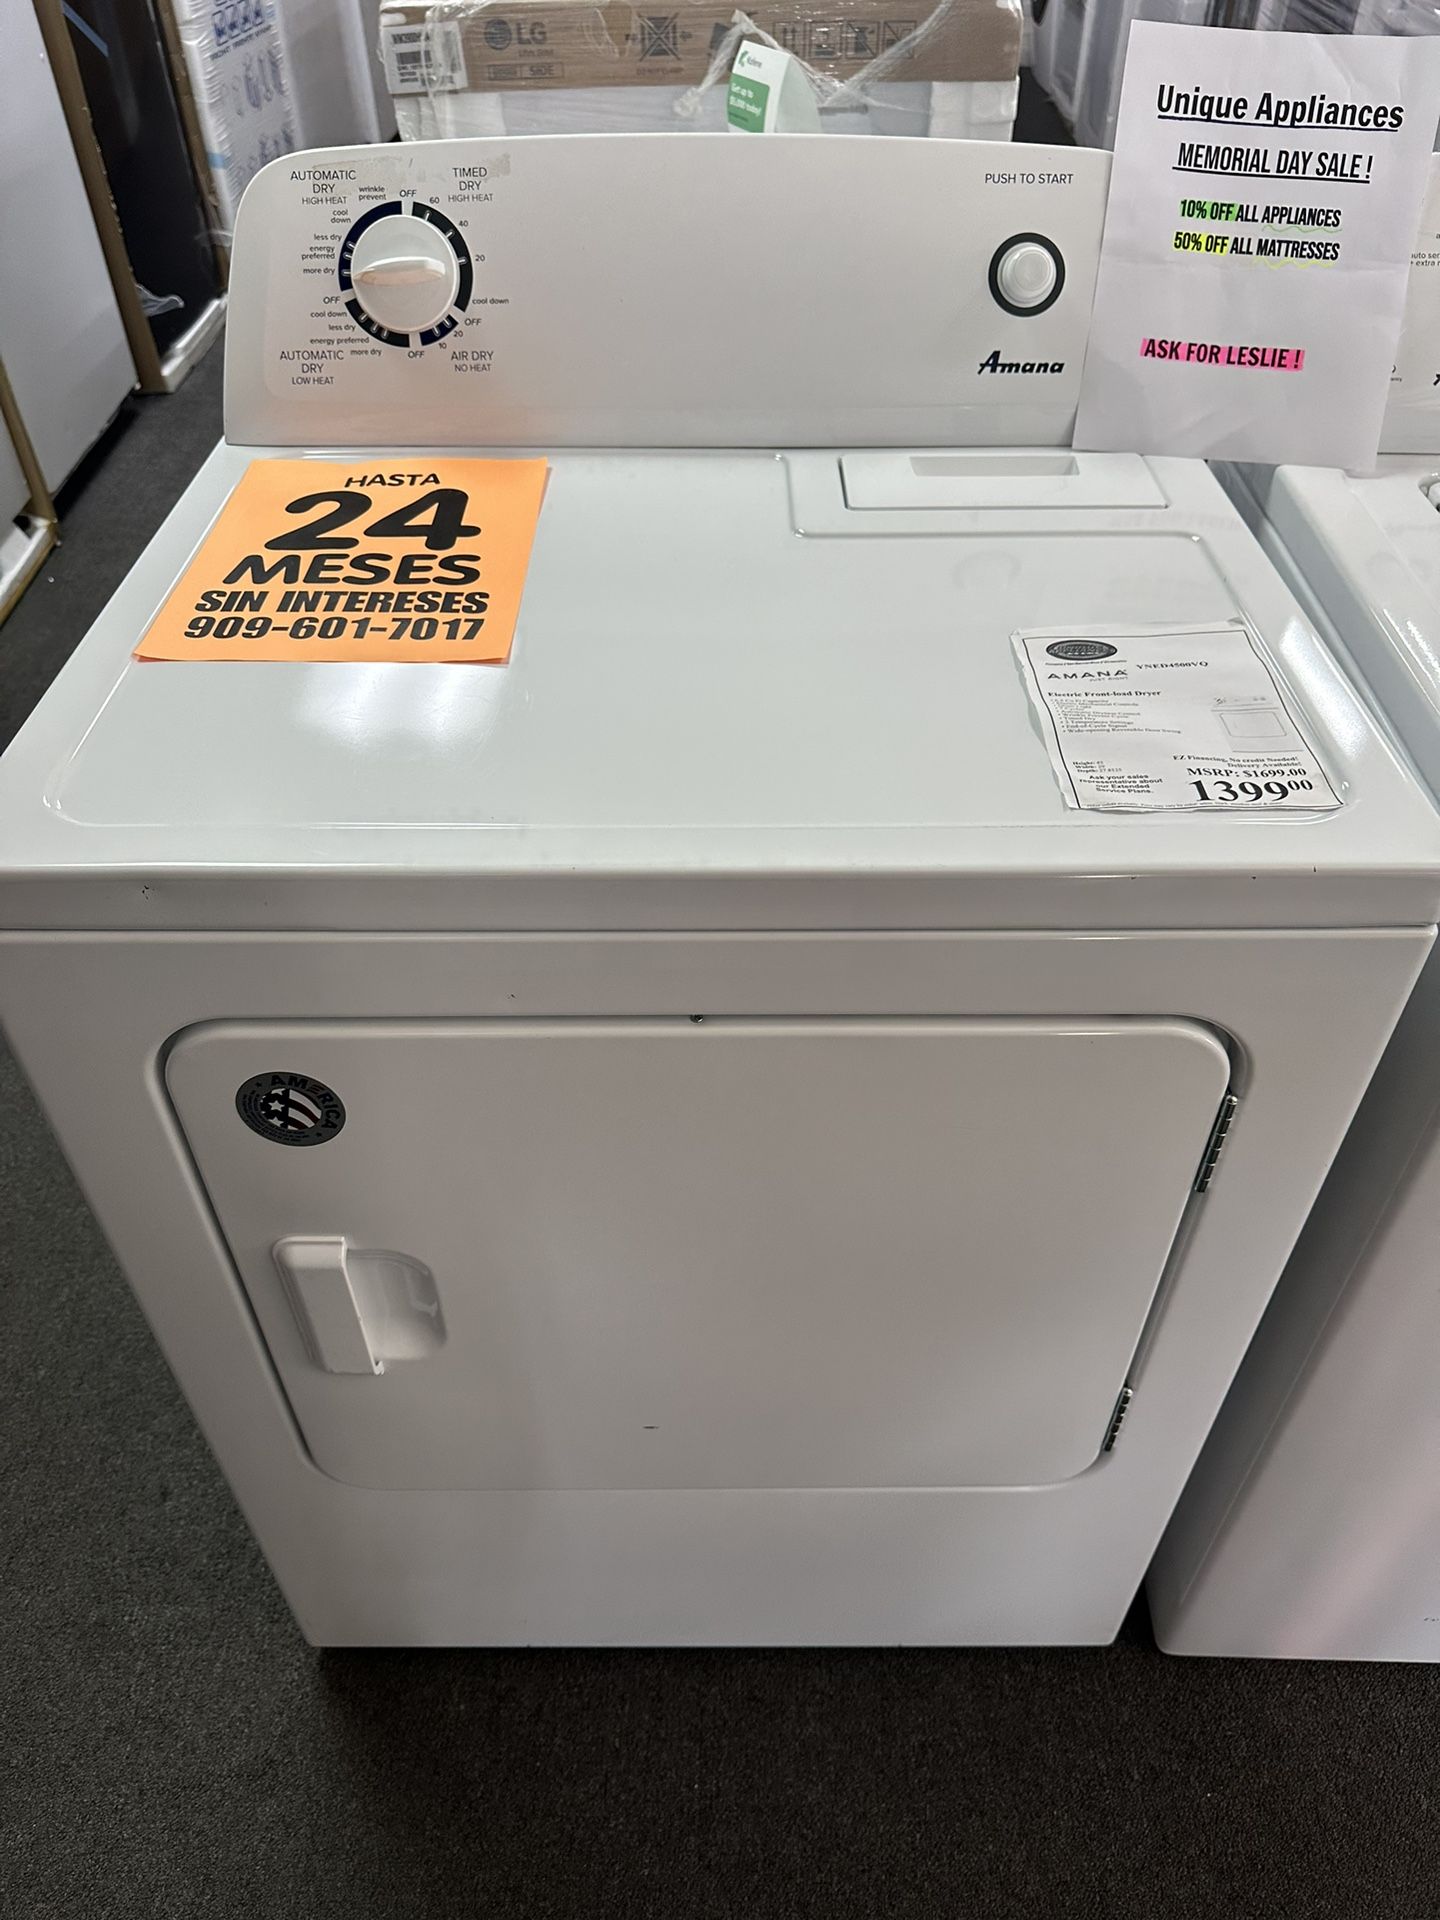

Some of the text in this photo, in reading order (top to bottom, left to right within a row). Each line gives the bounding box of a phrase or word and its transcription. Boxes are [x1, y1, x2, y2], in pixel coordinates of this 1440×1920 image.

[516, 22, 547, 45] LG
[1156, 84, 1404, 129] Unique Appliances
[1178, 142, 1272, 174] MEMORIAL
[1275, 150, 1312, 176] DAY
[1315, 151, 1363, 178] SALE
[290, 169, 357, 181] AUTOMATIC
[452, 167, 487, 178] TIMED
[984, 173, 1074, 185] PUSH TO START
[312, 183, 335, 194] DRY
[459, 180, 482, 191] DRY
[358, 194, 387, 202] prevent
[399, 189, 417, 198] OFF
[448, 193, 493, 203] HIGH HEAT
[301, 196, 347, 205] HIGH HEAT
[429, 196, 440, 204] 60
[1180, 199, 1342, 227] 10% OFF ALL APPLIANCES
[331, 216, 351, 224] down
[458, 220, 468, 228] 40
[314, 233, 342, 242] less dry
[1173, 232, 1340, 261] 50% OFF ALL MATTRESSES
[301, 252, 335, 261] preferred
[475, 254, 485, 262] 20
[322, 267, 335, 276] dry
[323, 296, 341, 304] OFF
[489, 297, 509, 305] down
[464, 318, 482, 326] OFF
[344, 324, 356, 332] dry
[336, 336, 370, 345] preferred
[279, 350, 344, 361] AUTOMATIC
[370, 348, 382, 356] dry
[407, 351, 425, 359] OFF
[450, 351, 494, 361] AIR DRY
[1143, 338, 1180, 361] ASK
[1186, 342, 1221, 364] FOR
[1226, 345, 1287, 368] LESLIE
[977, 350, 1065, 375] Amana
[301, 363, 324, 374] DRY
[454, 364, 491, 372] NO HEAT
[292, 377, 335, 385] LOW HEAT
[344, 472, 441, 488] HASTA
[264, 488, 482, 551] 24
[222, 553, 482, 585] MESES
[194, 590, 490, 614] SIN INTERESES
[183, 616, 486, 641] 909-601-7017
[1047, 669, 1128, 680] AMANA
[1186, 767, 1307, 778] MSRP: $1699.00
